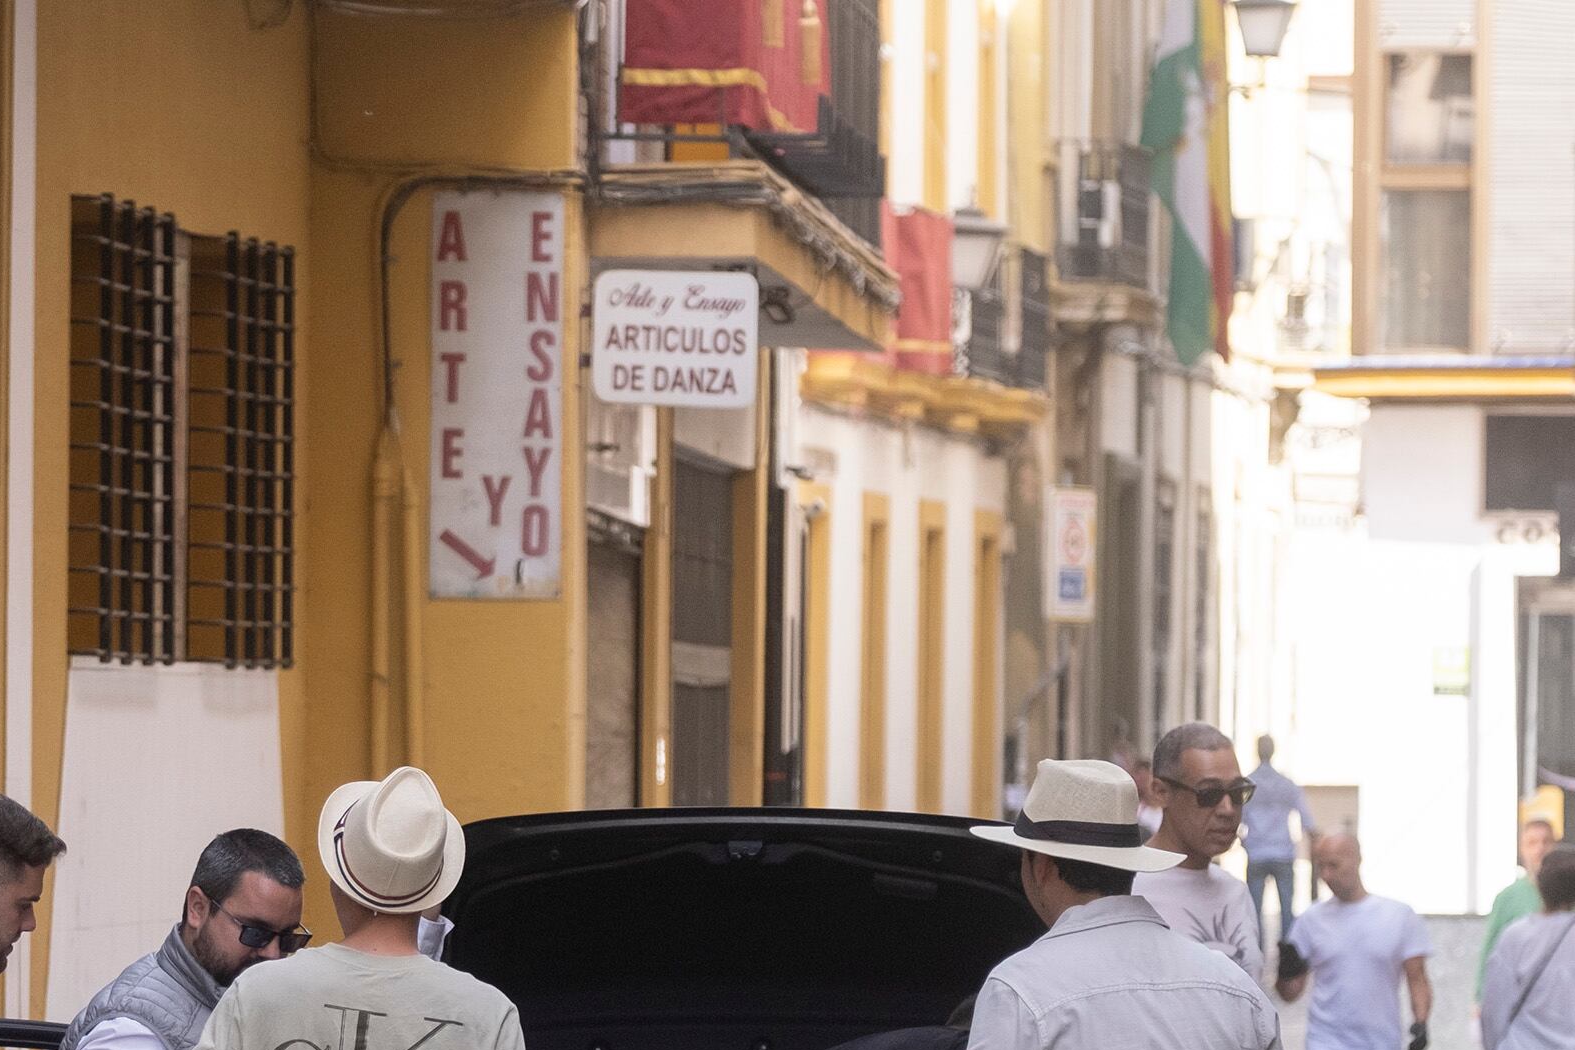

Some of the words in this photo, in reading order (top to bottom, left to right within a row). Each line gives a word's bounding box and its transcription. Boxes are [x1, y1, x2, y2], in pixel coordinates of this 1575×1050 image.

[437, 211, 467, 479] ARTE
[522, 212, 560, 557] ENSAYO
[605, 325, 747, 355] ARTICULOS
[613, 364, 644, 391] DE
[654, 366, 737, 394] DANZA
